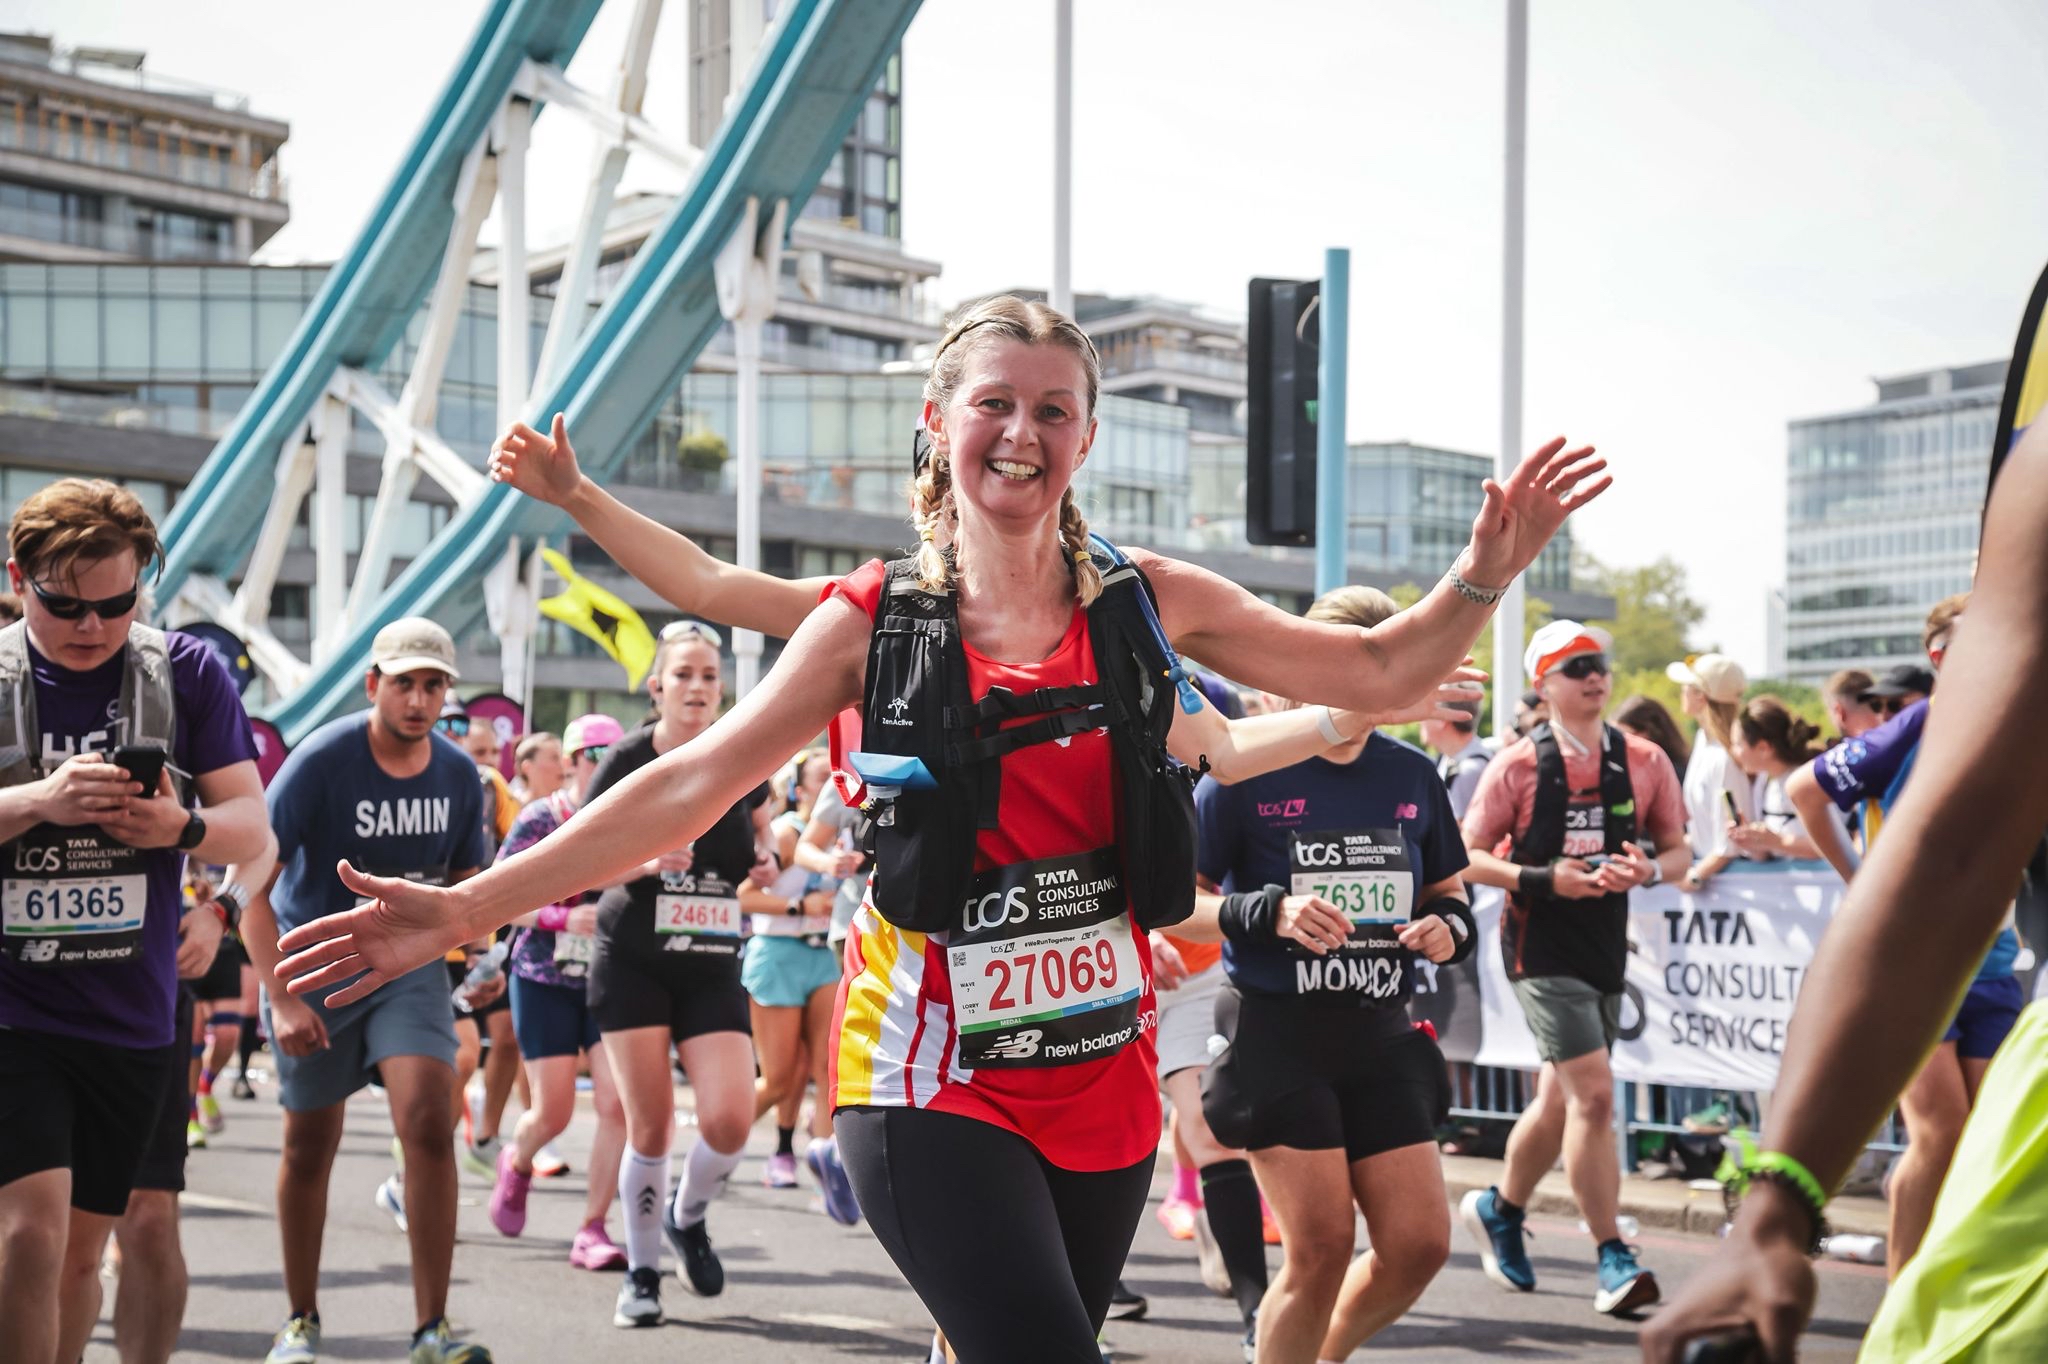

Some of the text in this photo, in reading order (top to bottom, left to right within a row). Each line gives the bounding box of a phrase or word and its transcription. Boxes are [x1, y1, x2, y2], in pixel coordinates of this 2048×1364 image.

[882, 717, 914, 726] ZenActive
[355, 797, 450, 838] SAMIN
[66, 839, 98, 849] TATA
[1343, 835, 1372, 845] TATA
[15, 840, 61, 872] tcs
[66, 848, 136, 860] CONSULTANCY
[1295, 840, 1342, 867] tcs
[1346, 855, 1386, 866] SERVICES
[66, 860, 112, 871] SERVICES
[1034, 868, 1079, 887] TATA
[26, 886, 124, 920] 61365
[671, 903, 730, 925] 24614
[963, 886, 1029, 932] tcs
[1038, 898, 1100, 920] SERVICES
[1664, 911, 1755, 945] TATA
[60, 947, 133, 961] new balance
[984, 939, 1118, 1011] 27069
[1664, 961, 1805, 1001] CONSULT
[1000, 1018, 1022, 1027] MEDAL
[1045, 1027, 1132, 1058] new balance
